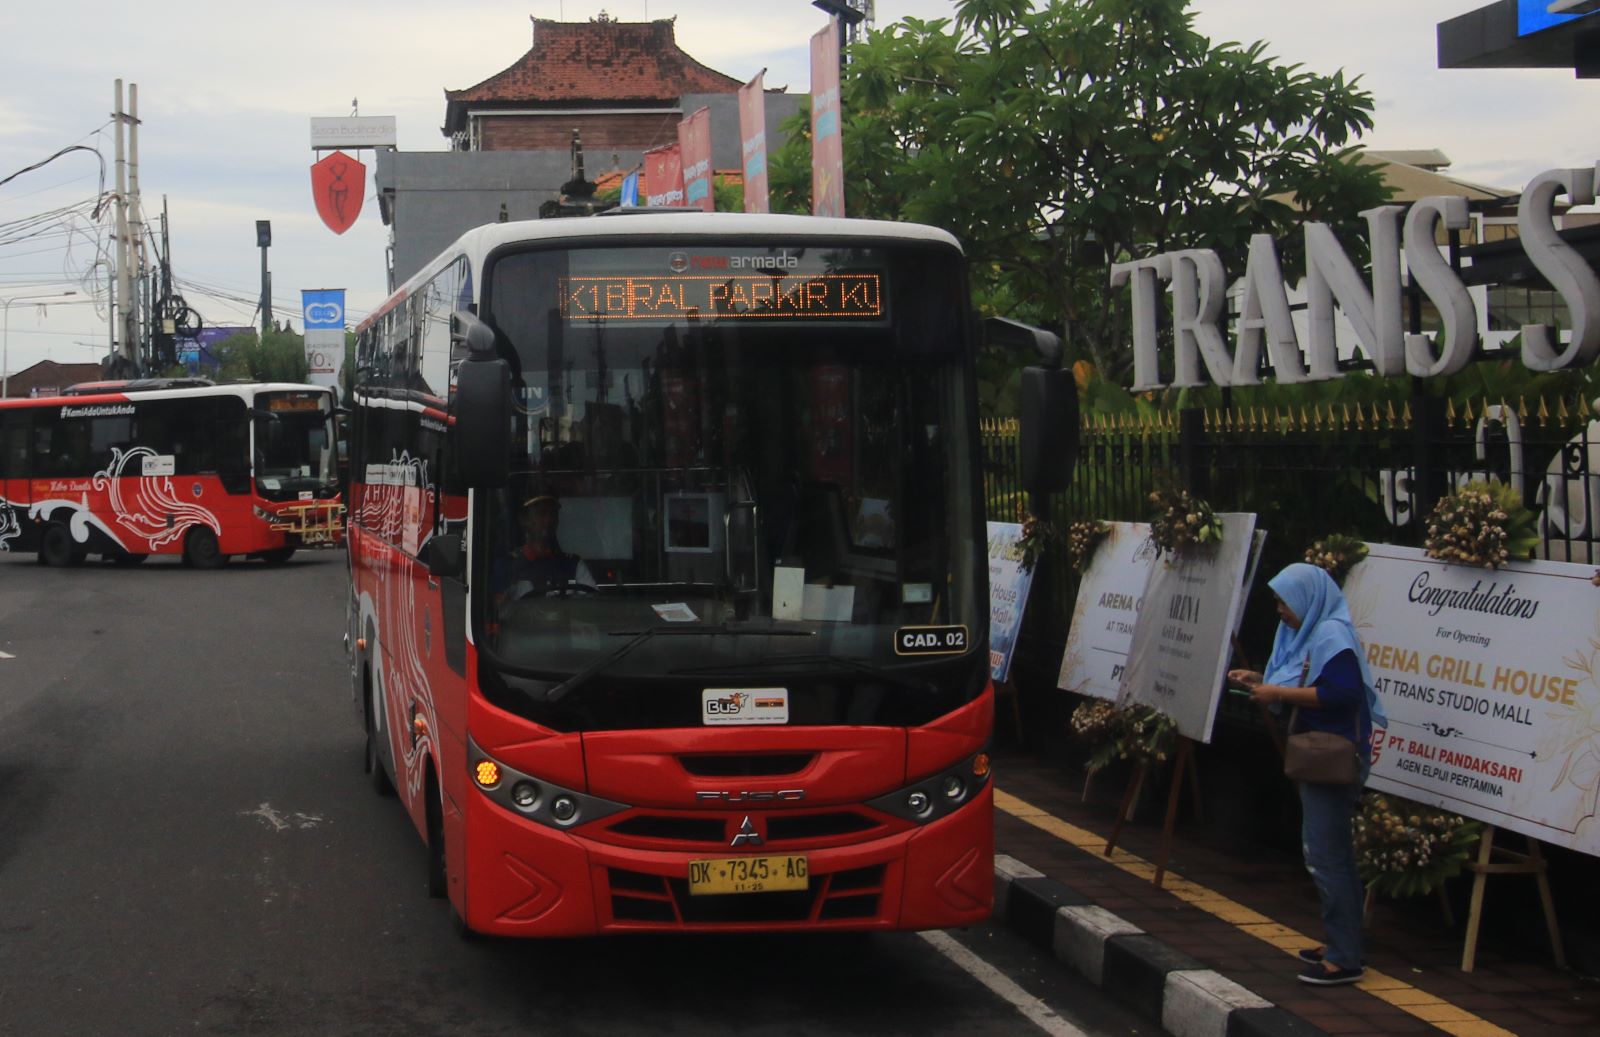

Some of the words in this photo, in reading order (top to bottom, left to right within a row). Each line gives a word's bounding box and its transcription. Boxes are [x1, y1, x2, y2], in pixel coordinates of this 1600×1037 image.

[691, 254, 728, 268] new
[729, 249, 798, 269] armada
[1110, 195, 1478, 392] TRANS
[1518, 158, 1600, 372] S
[709, 283, 828, 309] PARKIR
[1099, 593, 1133, 610] ARENA
[1408, 571, 1539, 619] Congratulations
[903, 632, 942, 647] CAD.
[945, 632, 964, 646] 02
[1116, 622, 1133, 634] TRAN
[1436, 627, 1452, 638] For
[1452, 630, 1491, 648] Opening
[1363, 642, 1420, 674] RENA
[1427, 654, 1486, 688] GRILL
[1492, 666, 1579, 705] HOUSE
[706, 699, 741, 714] Bus
[1374, 677, 1391, 691] AT
[1393, 682, 1434, 702] TRANS
[1437, 690, 1489, 715] STUDIO
[1492, 703, 1533, 725] MALL
[1388, 735, 1405, 752] PT.
[1408, 740, 1436, 760] BALI
[1439, 748, 1523, 783] PANDAKSARI
[1396, 758, 1421, 773] AGEN
[1422, 765, 1449, 782] ELPIJI
[1450, 773, 1503, 797] PERTAMINA
[696, 790, 804, 800] FUSO
[690, 863, 710, 884] DK
[728, 859, 768, 881] 7345
[786, 858, 806, 879] AG
